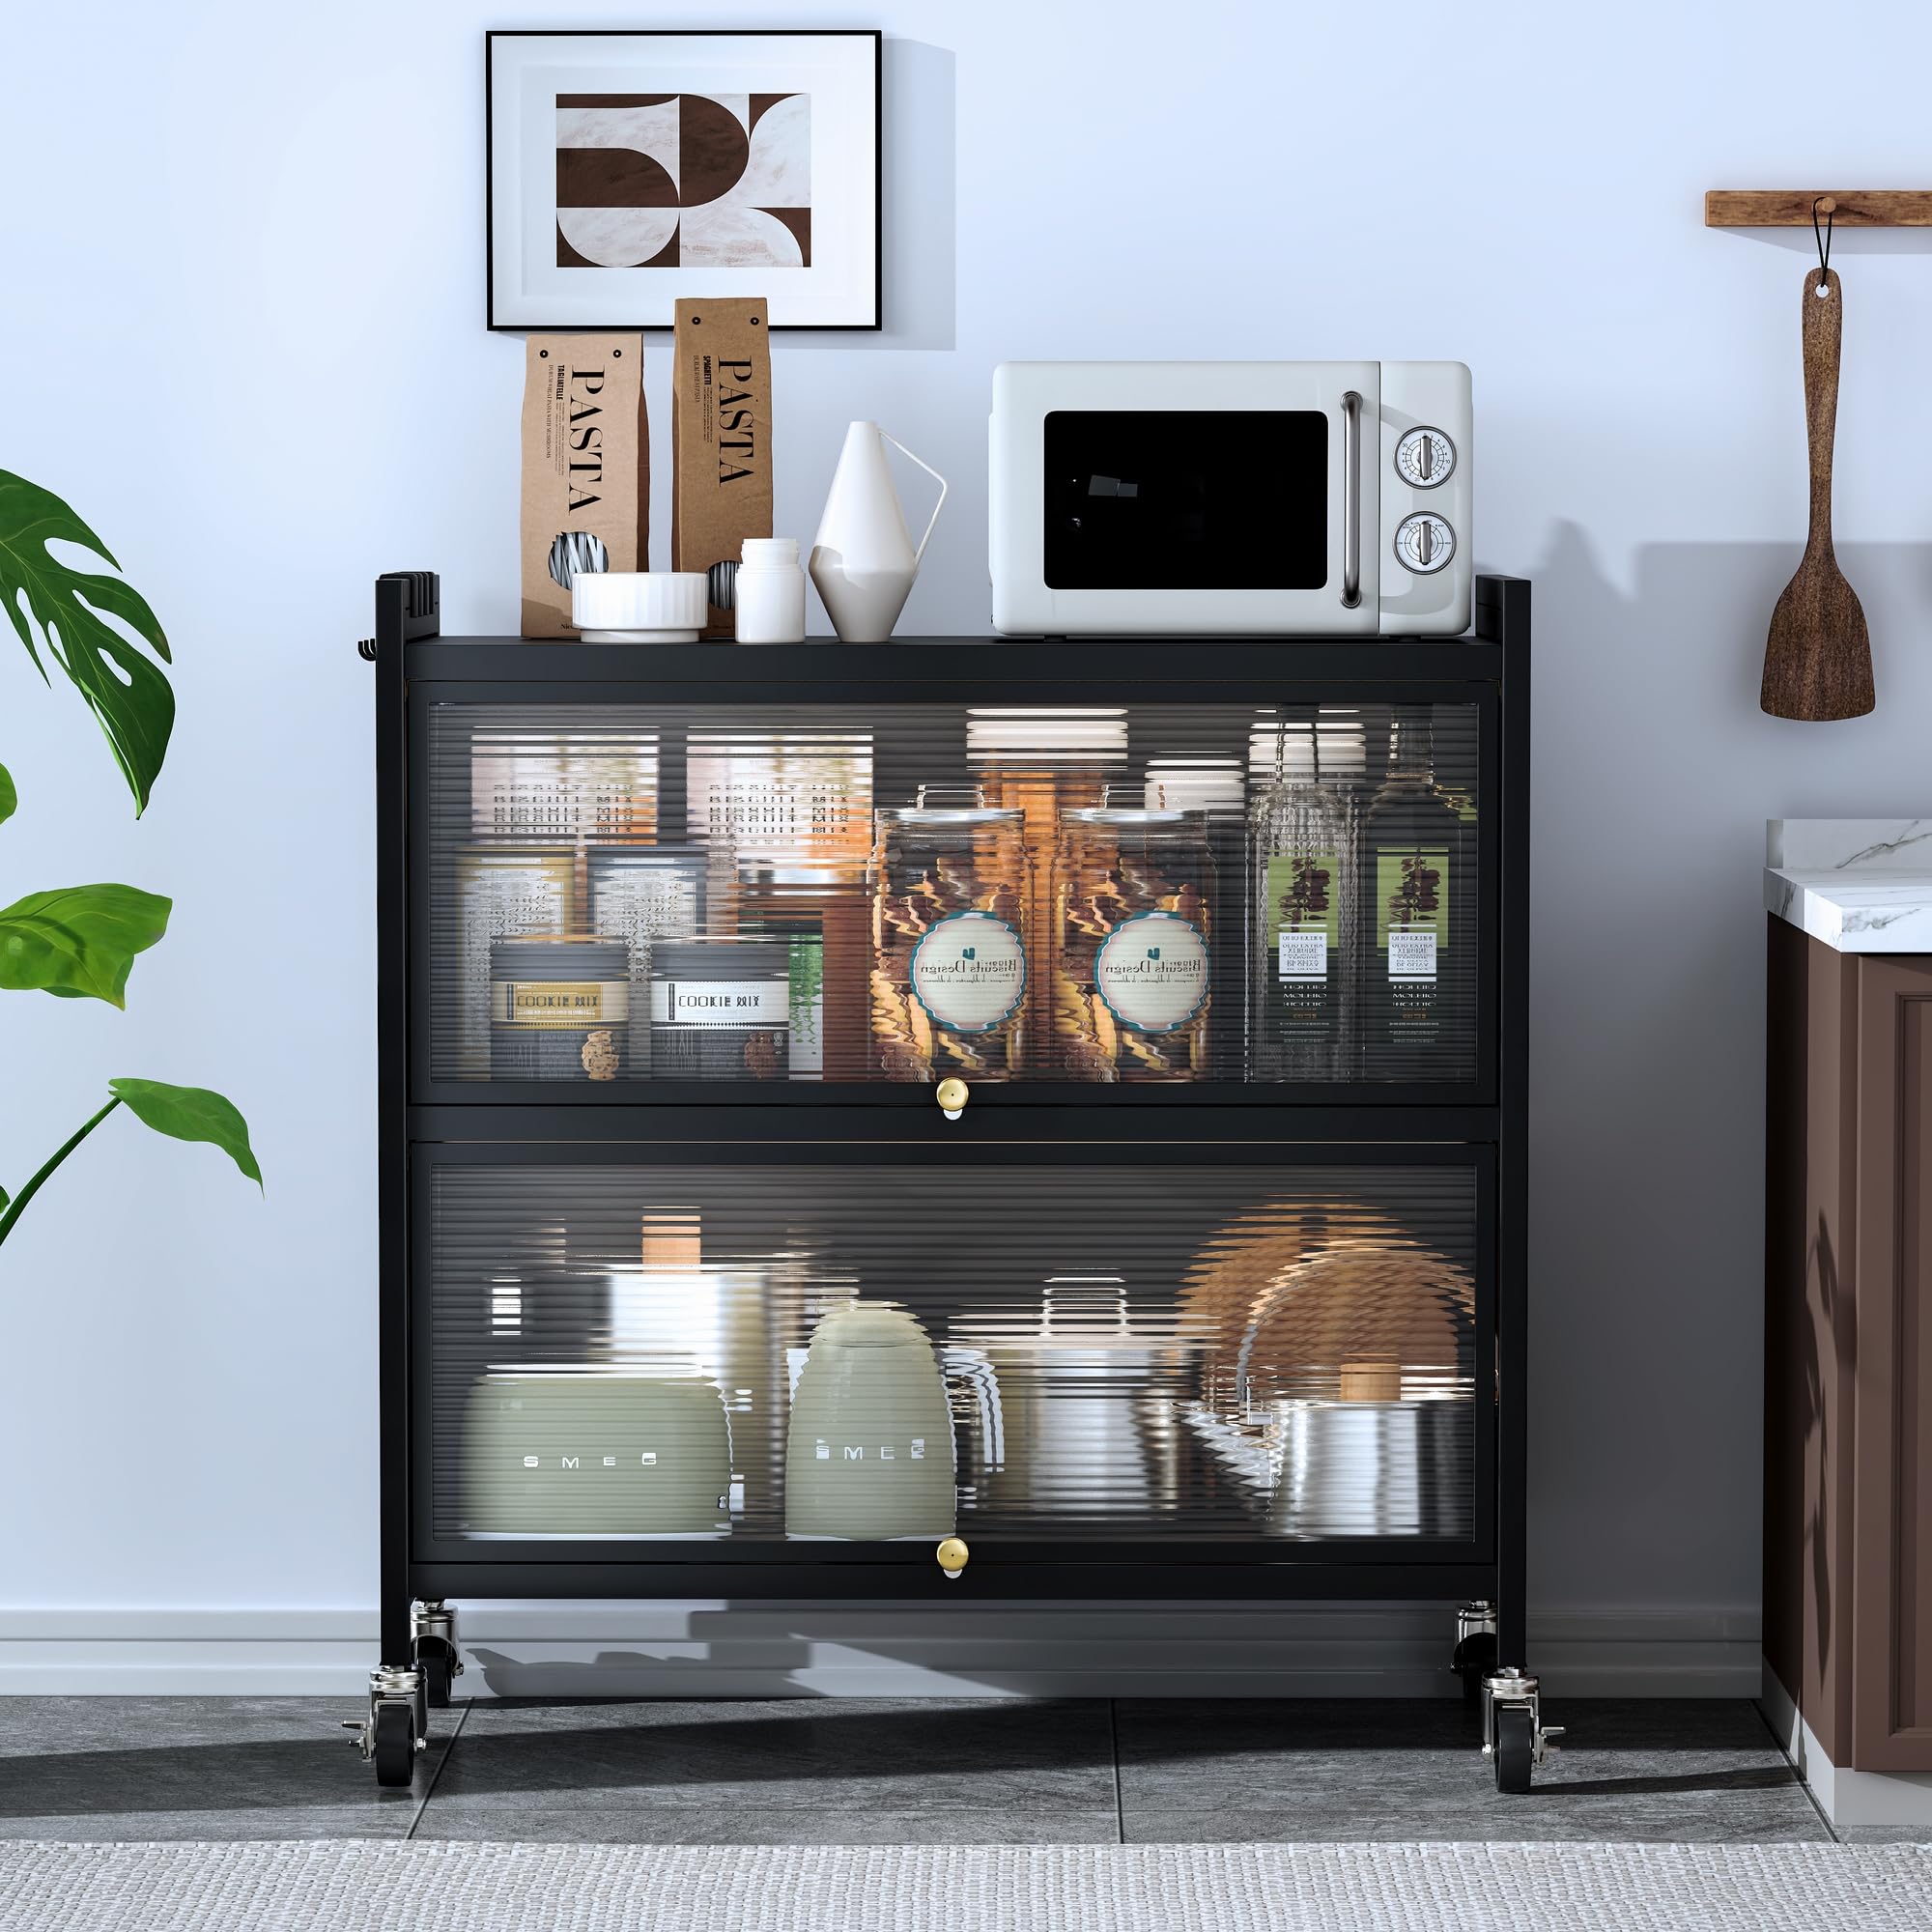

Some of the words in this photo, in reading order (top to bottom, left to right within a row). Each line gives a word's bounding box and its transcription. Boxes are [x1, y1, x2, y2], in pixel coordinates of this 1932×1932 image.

[555, 364, 565, 401] TAGLIATELLE
[702, 355, 712, 385] SPAGHETTI
[718, 355, 754, 488] PASTA
[568, 363, 605, 517] PASTA
[517, 995, 570, 1008] COOKIE
[575, 995, 599, 1008] MIX
[678, 995, 731, 1008] COOKIE
[736, 995, 760, 1008] MIX
[523, 1452, 657, 1468] SMEG
[815, 1438, 924, 1460] SMEG
